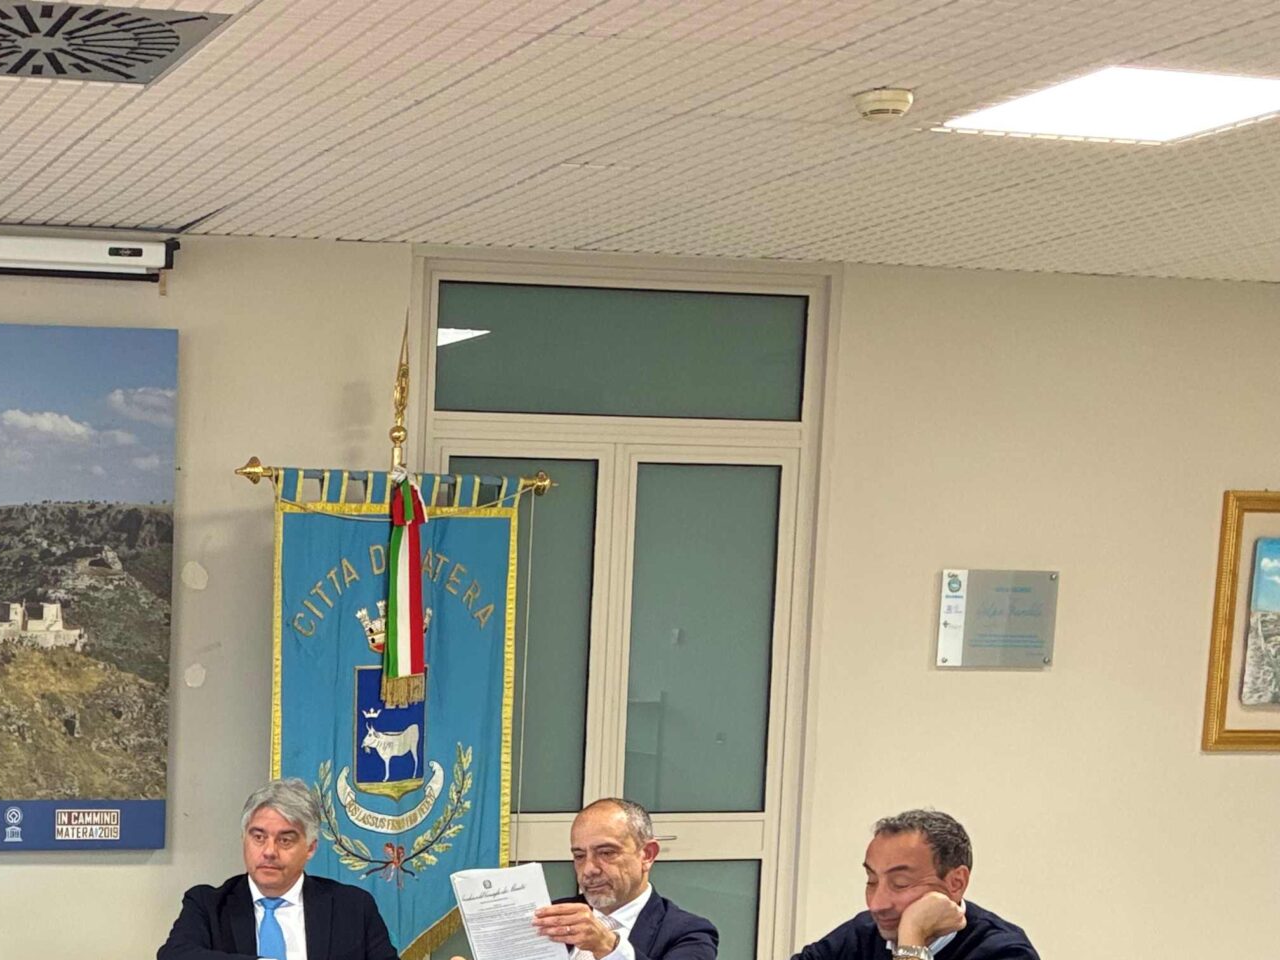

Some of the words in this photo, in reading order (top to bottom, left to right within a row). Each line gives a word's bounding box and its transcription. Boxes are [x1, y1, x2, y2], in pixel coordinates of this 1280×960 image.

[293, 557, 360, 638] CITTA
[420, 546, 496, 632] ATERA
[57, 811, 68, 825] IN
[71, 811, 118, 825] CAMMINO
[56, 826, 95, 839] MATERA
[98, 826, 119, 838] 2019
